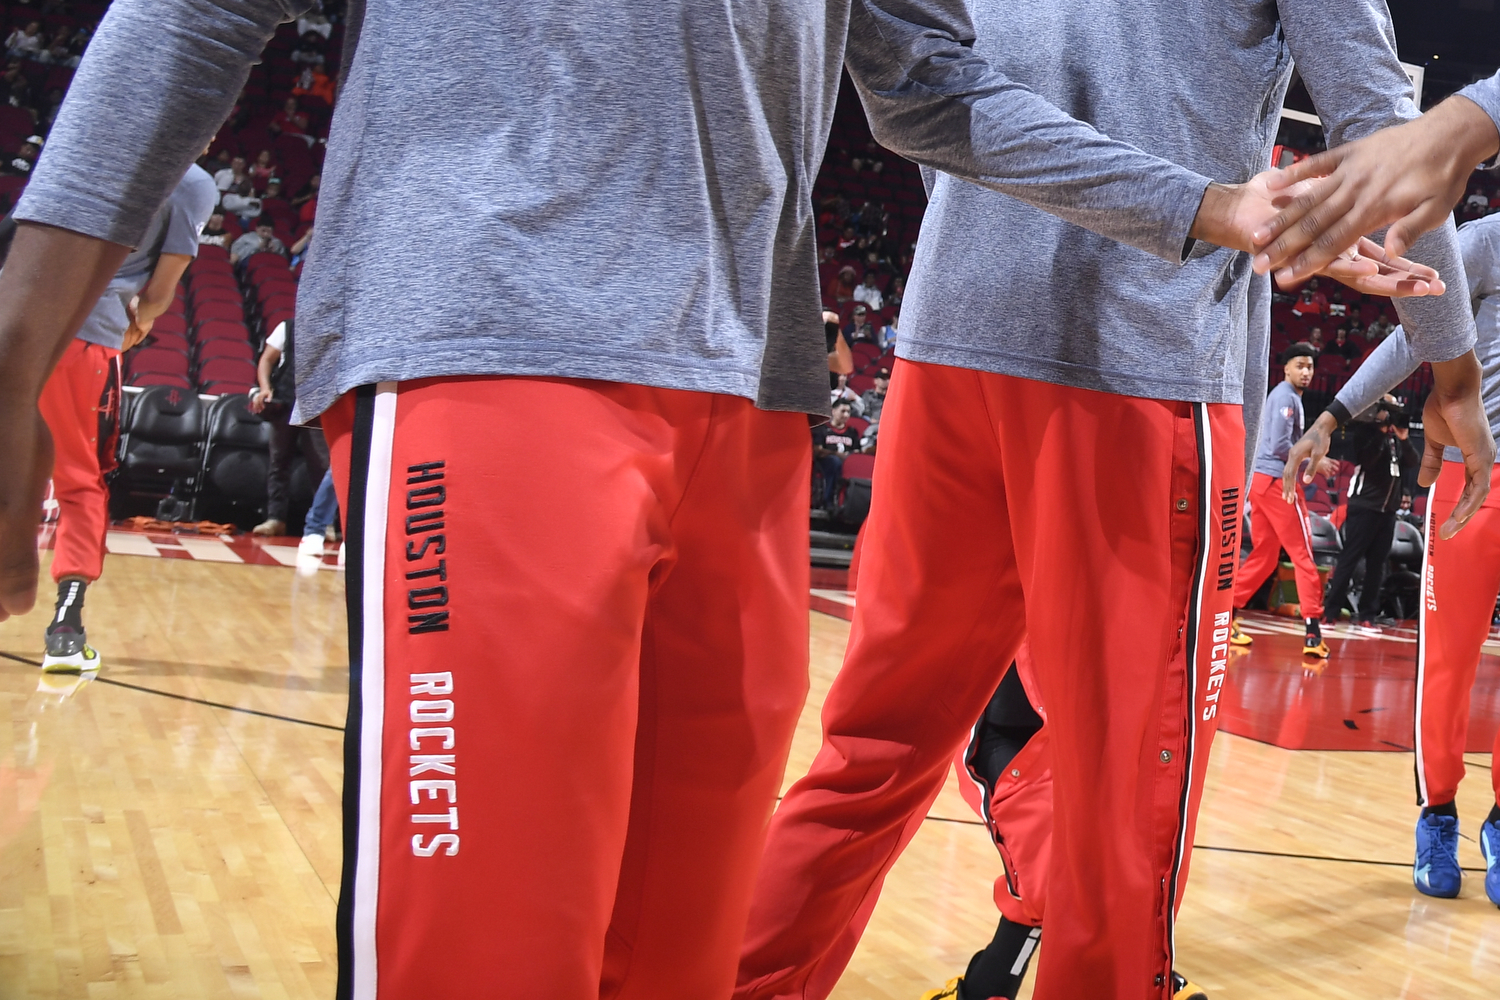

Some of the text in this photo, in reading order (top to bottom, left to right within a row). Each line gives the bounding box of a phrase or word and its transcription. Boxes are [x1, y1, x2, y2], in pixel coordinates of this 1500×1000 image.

[405, 459, 460, 857] HOUSTON ROCKETS
[1203, 486, 1239, 722] HOUSTON ROCKETS
[1426, 564, 1438, 612] ROCKETS
